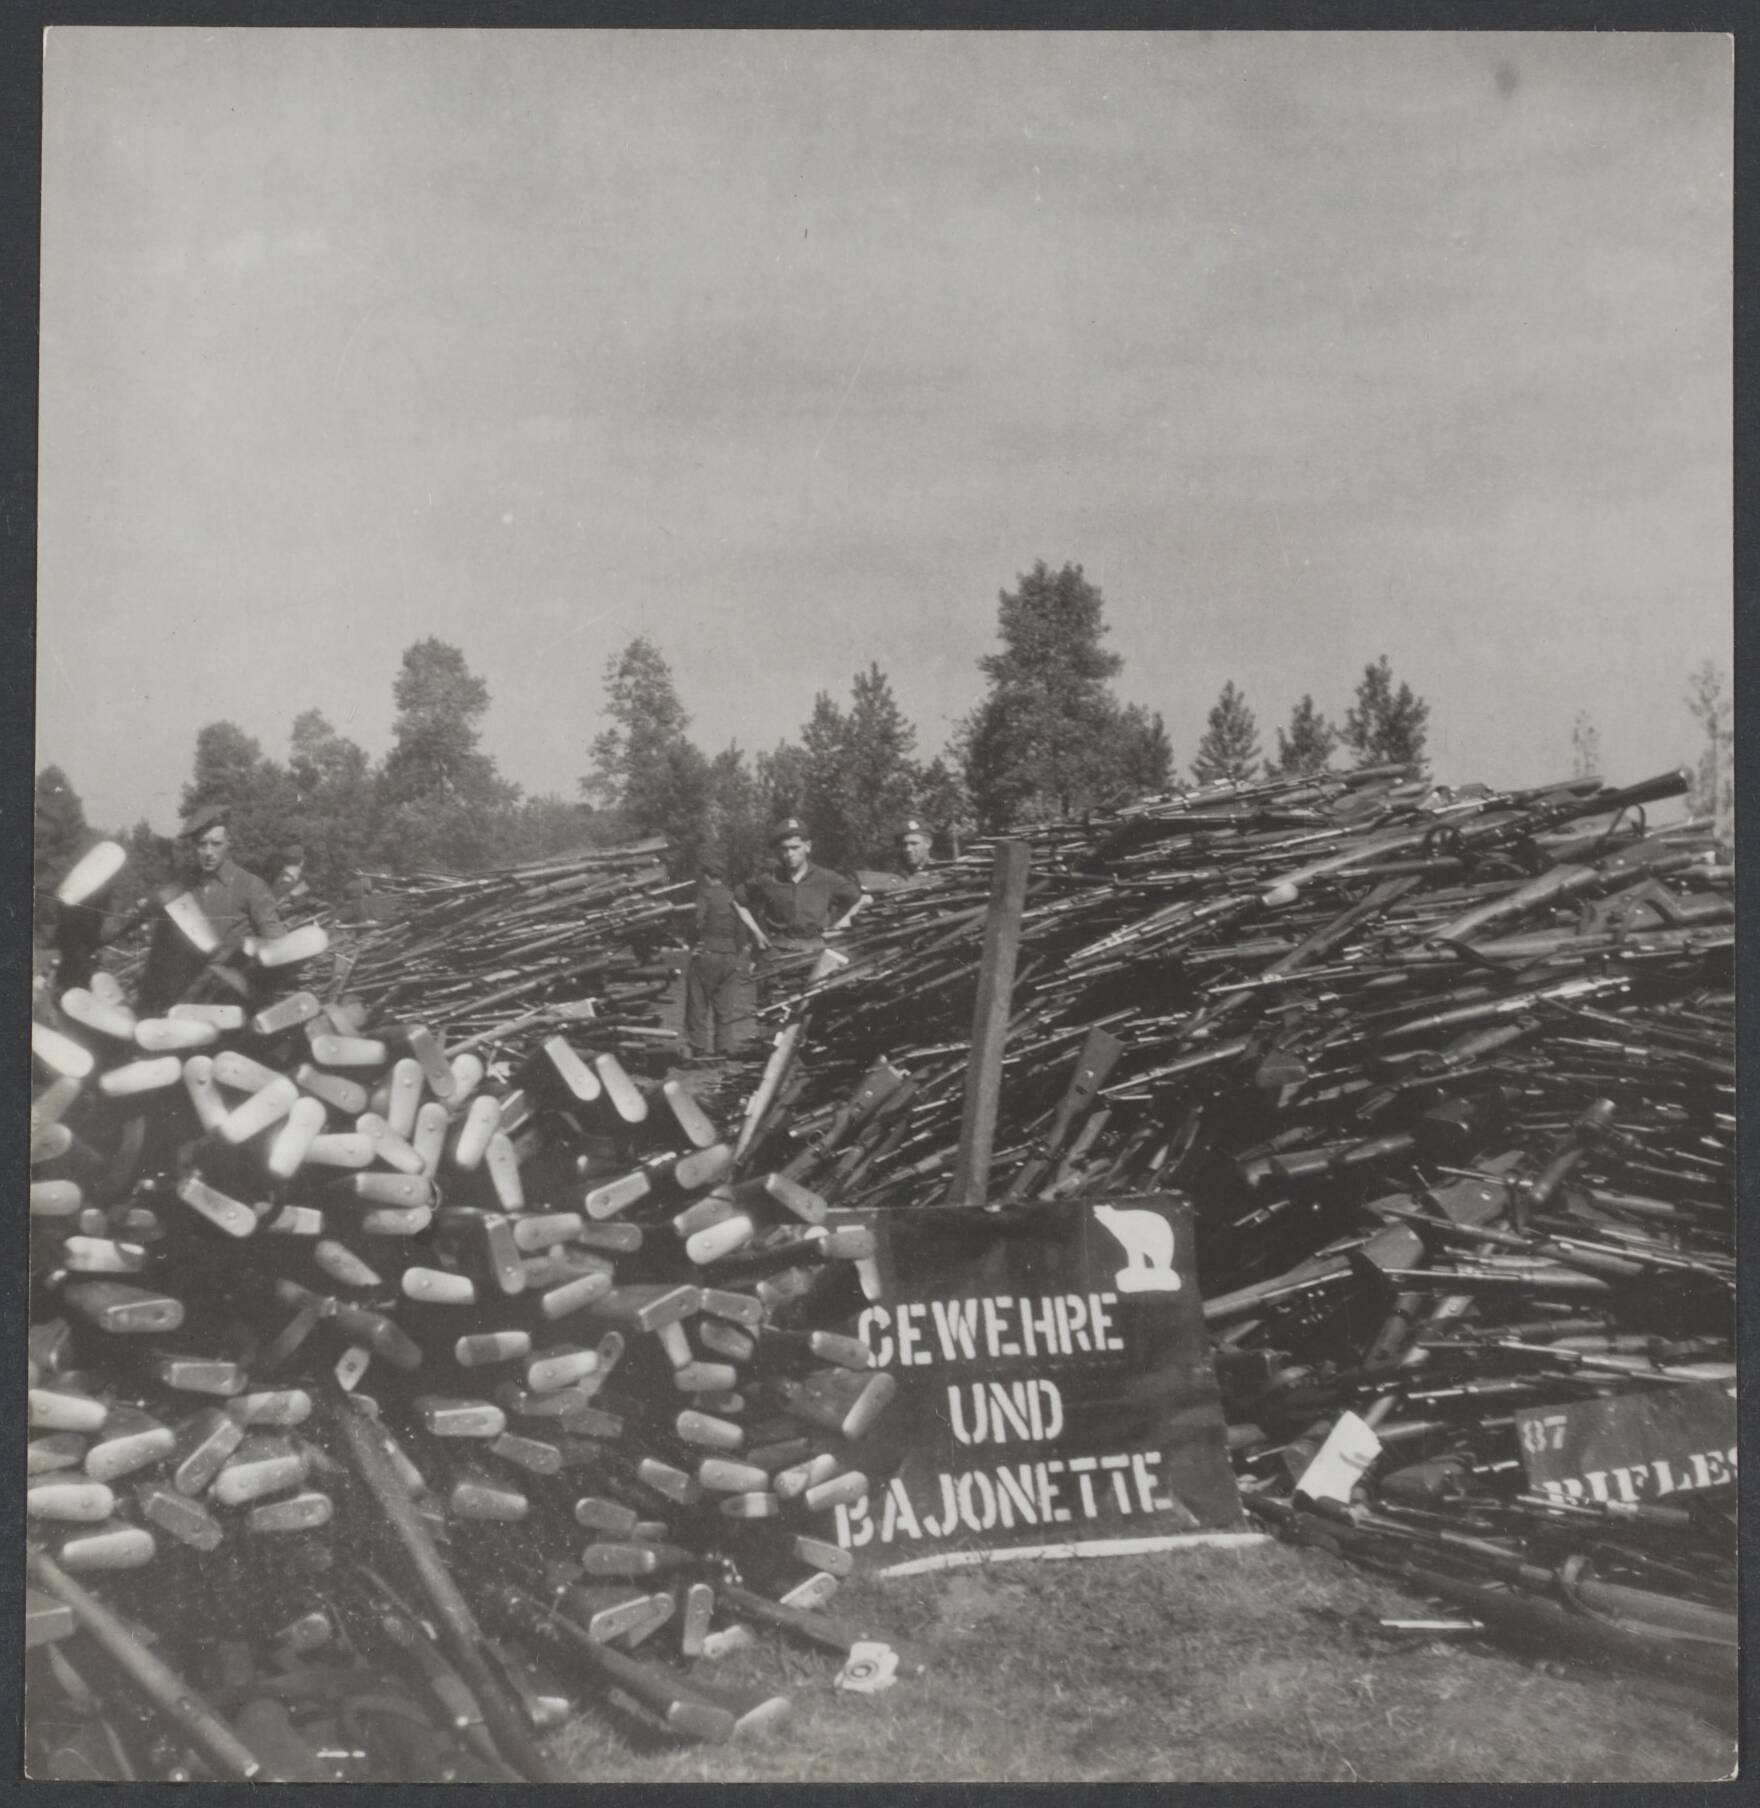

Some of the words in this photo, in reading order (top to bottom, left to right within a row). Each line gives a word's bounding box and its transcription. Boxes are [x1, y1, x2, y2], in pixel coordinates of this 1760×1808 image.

[947, 1379, 1064, 1445] UND
[1522, 1415, 1568, 1454] 87
[834, 1451, 1174, 1549] BAJONETTE
